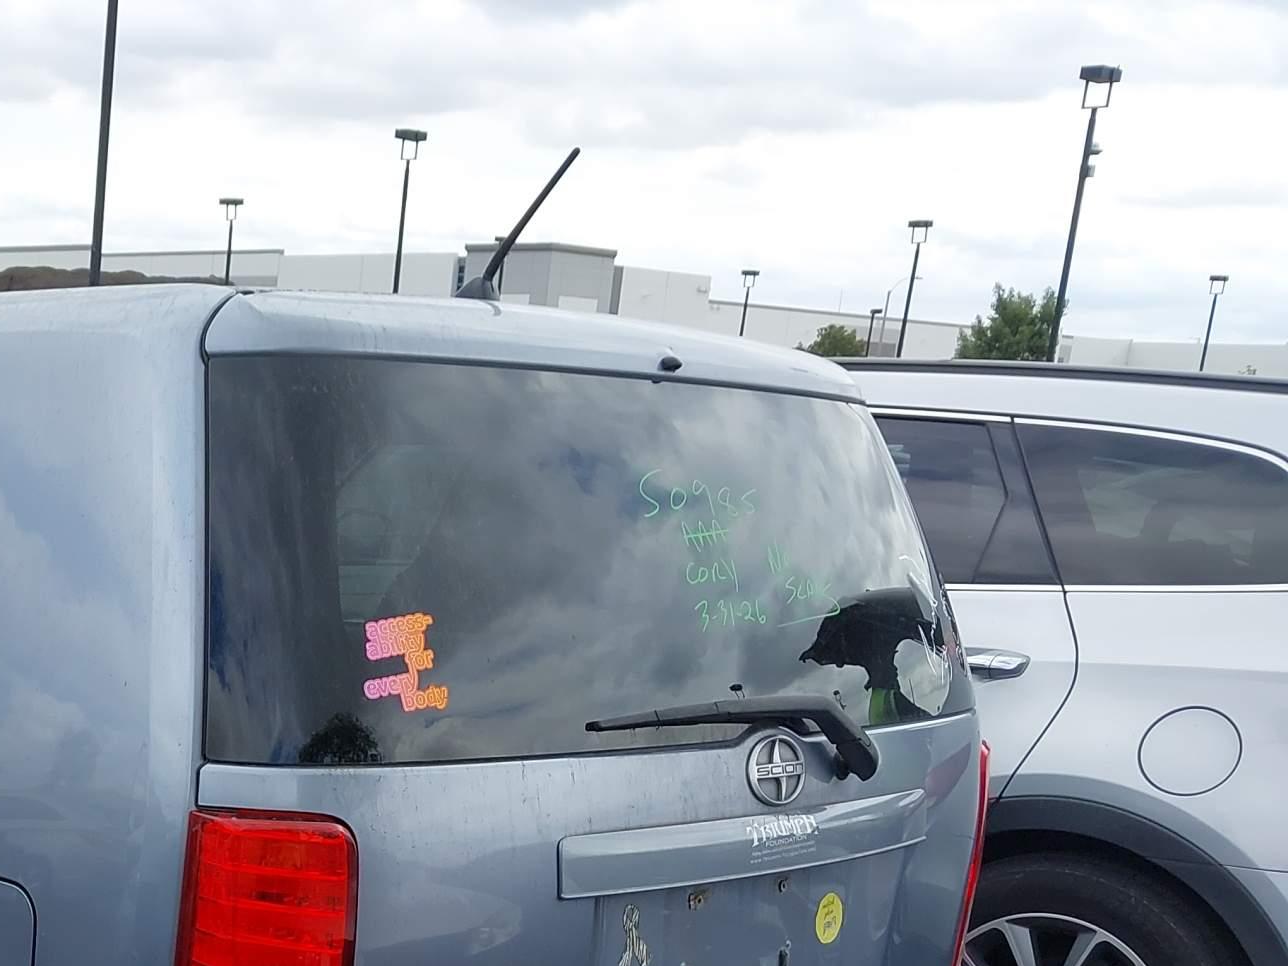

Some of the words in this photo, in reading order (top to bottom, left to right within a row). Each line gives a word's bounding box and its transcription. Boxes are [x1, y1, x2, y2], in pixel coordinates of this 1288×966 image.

[366, 631, 425, 660] ability
[406, 650, 434, 674] for
[756, 763, 804, 778] SCION
[746, 814, 819, 848] TRIUMPH
[765, 835, 808, 848] FOUNDATION
